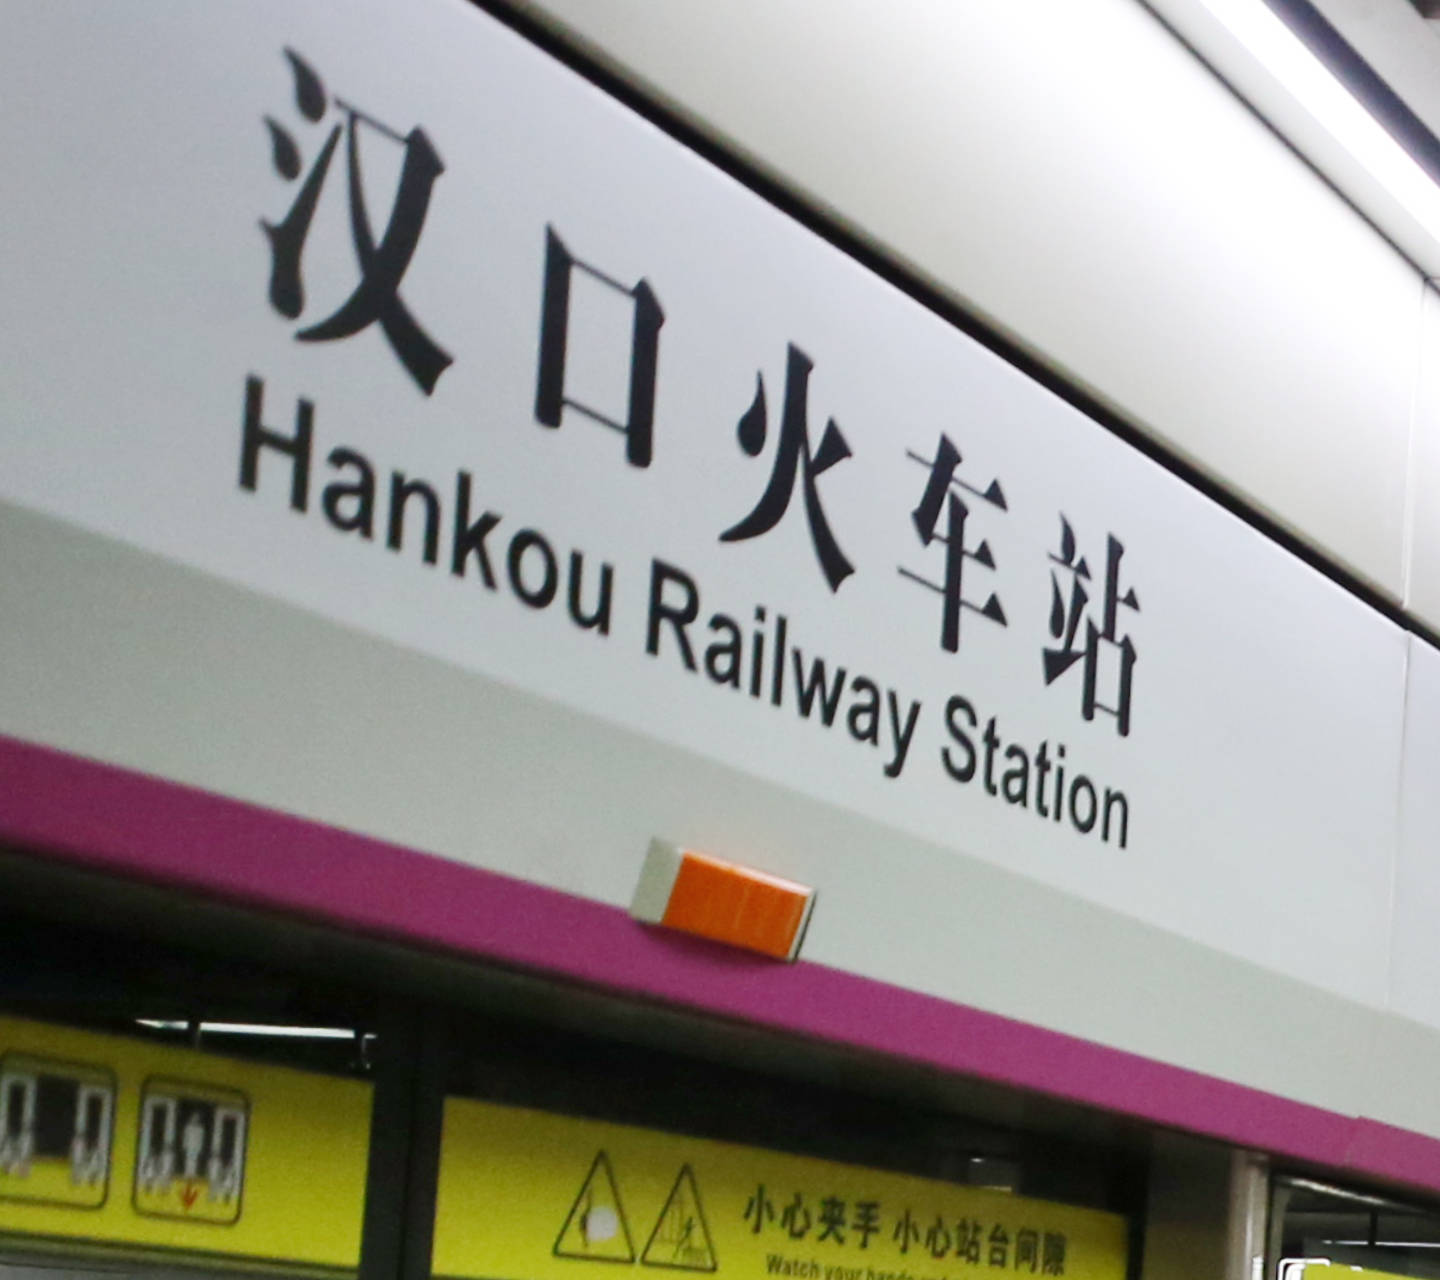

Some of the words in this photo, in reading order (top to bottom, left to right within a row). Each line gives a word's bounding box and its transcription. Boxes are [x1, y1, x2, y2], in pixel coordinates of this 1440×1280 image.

[256, 45, 1142, 737] 汉口火车站
[239, 374, 613, 640] Hankou
[648, 557, 921, 780] Railway
[940, 694, 1129, 849] Station
[744, 1183, 881, 1249] 小心夹手
[766, 1253, 819, 1279] Watch
